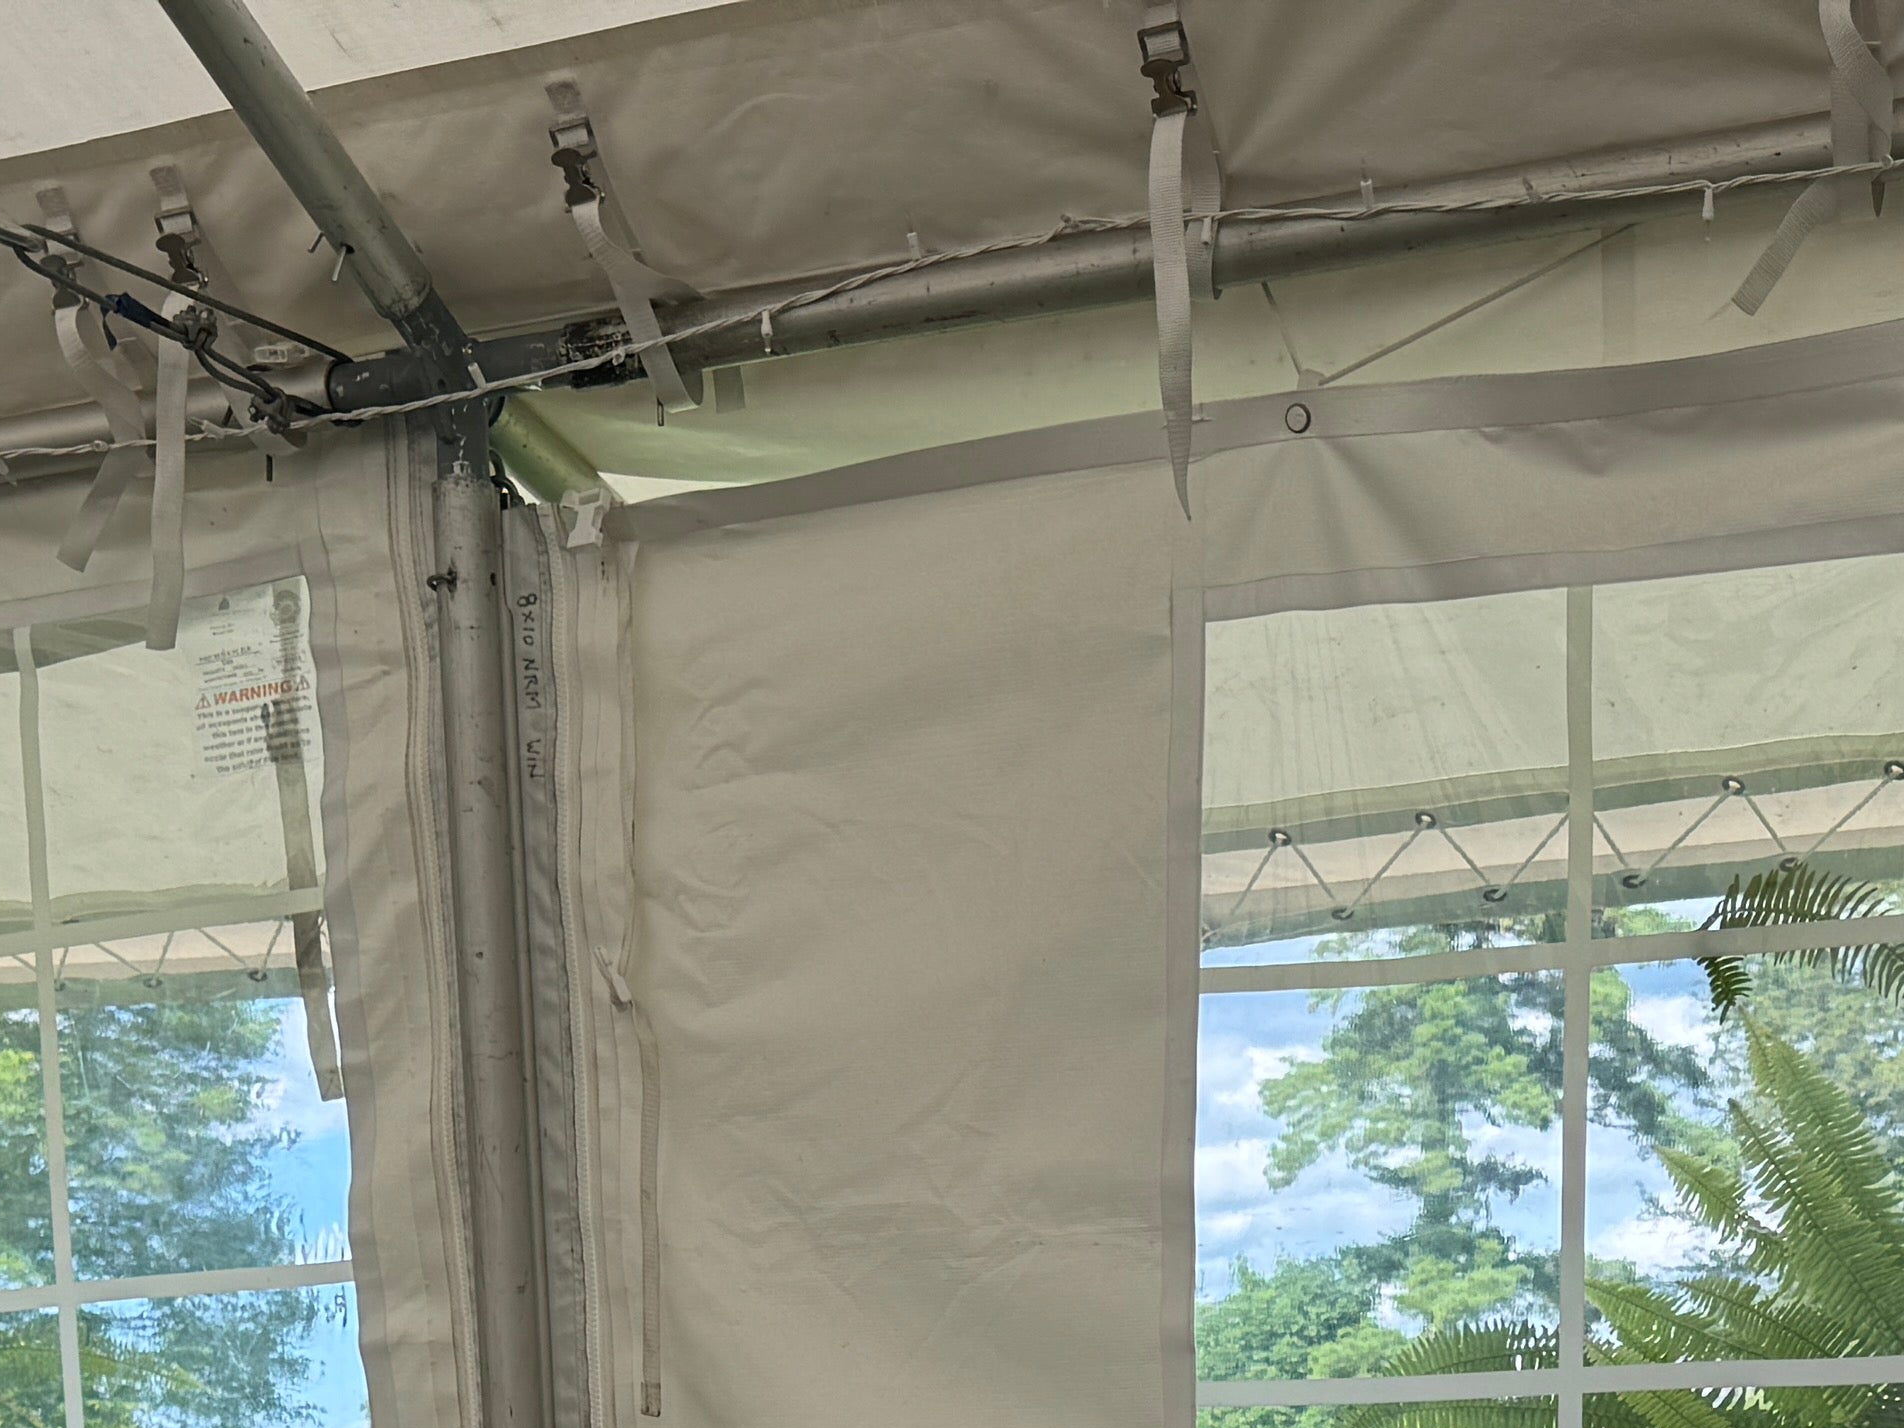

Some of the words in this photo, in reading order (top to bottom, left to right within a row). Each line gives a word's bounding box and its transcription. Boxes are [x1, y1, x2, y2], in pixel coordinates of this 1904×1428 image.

[213, 679, 293, 706] WARNING
[521, 657, 542, 710] NRM
[526, 738, 546, 779] WIN
